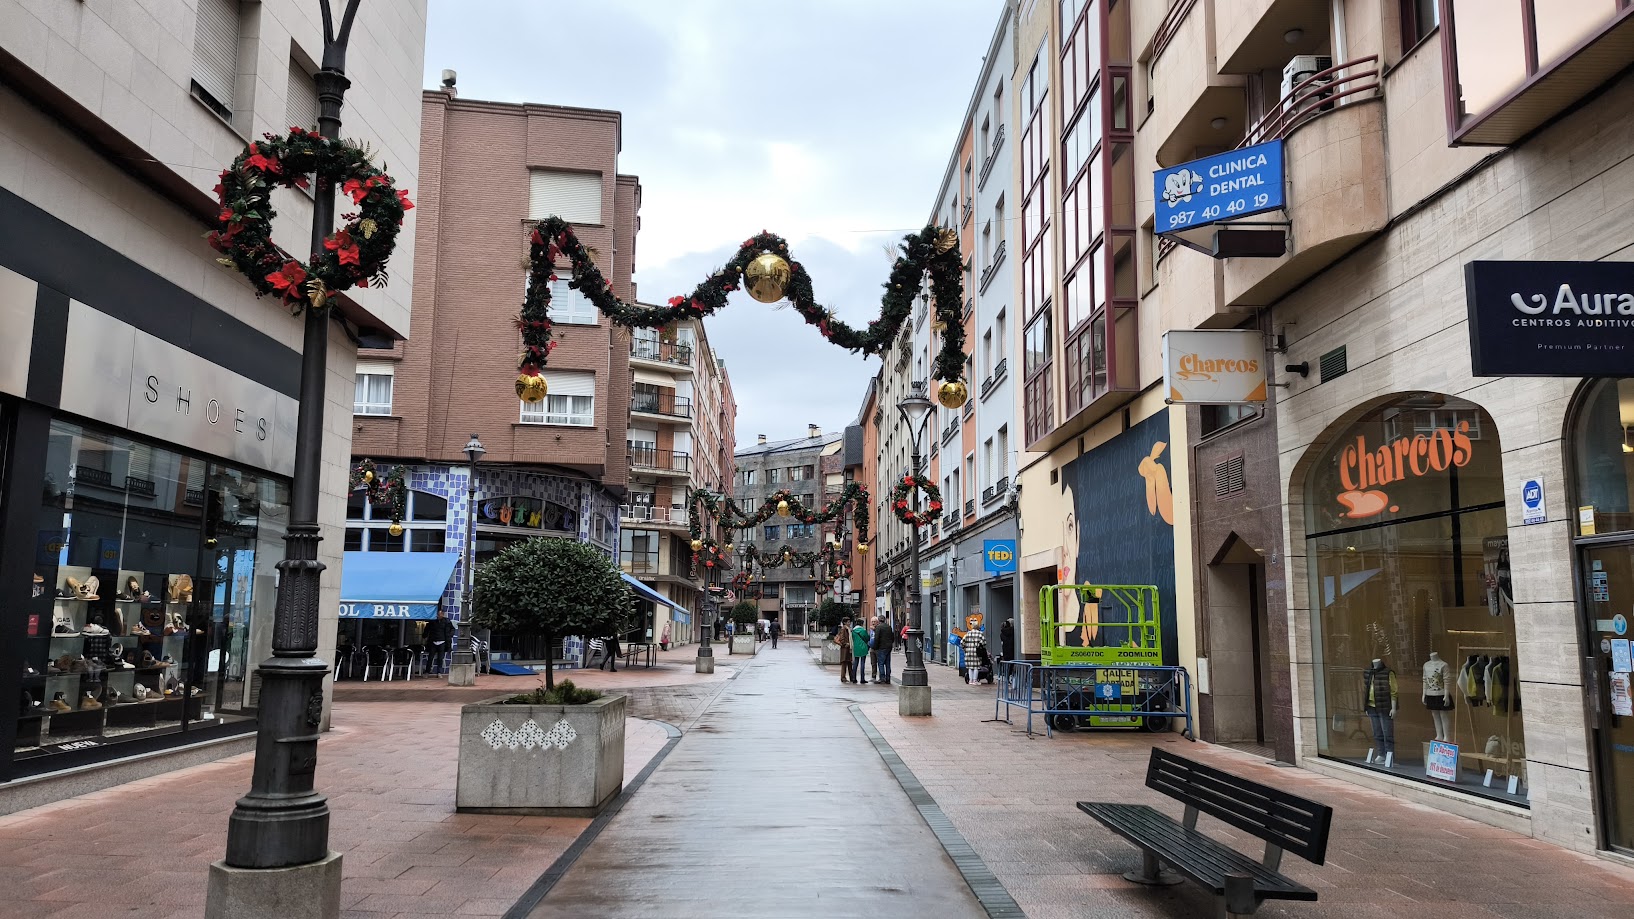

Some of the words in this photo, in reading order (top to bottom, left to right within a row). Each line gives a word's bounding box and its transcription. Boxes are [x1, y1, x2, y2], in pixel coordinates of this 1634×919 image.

[1209, 153, 1267, 178] CLINICA
[1210, 173, 1265, 197] DENTAL
[1169, 211, 1195, 228] 987
[1202, 204, 1220, 219] 40
[1226, 198, 1245, 213] 40
[1253, 193, 1269, 207] 19
[1552, 283, 1634, 315] Aura
[1512, 318, 1571, 327] CENTROS
[1179, 353, 1259, 373] Charcos
[144, 375, 267, 441] SHOES
[1339, 420, 1472, 490] Charcos
[1526, 489, 1539, 500] ADT
[988, 551, 1013, 560] TEDi
[373, 604, 411, 617] BAR
